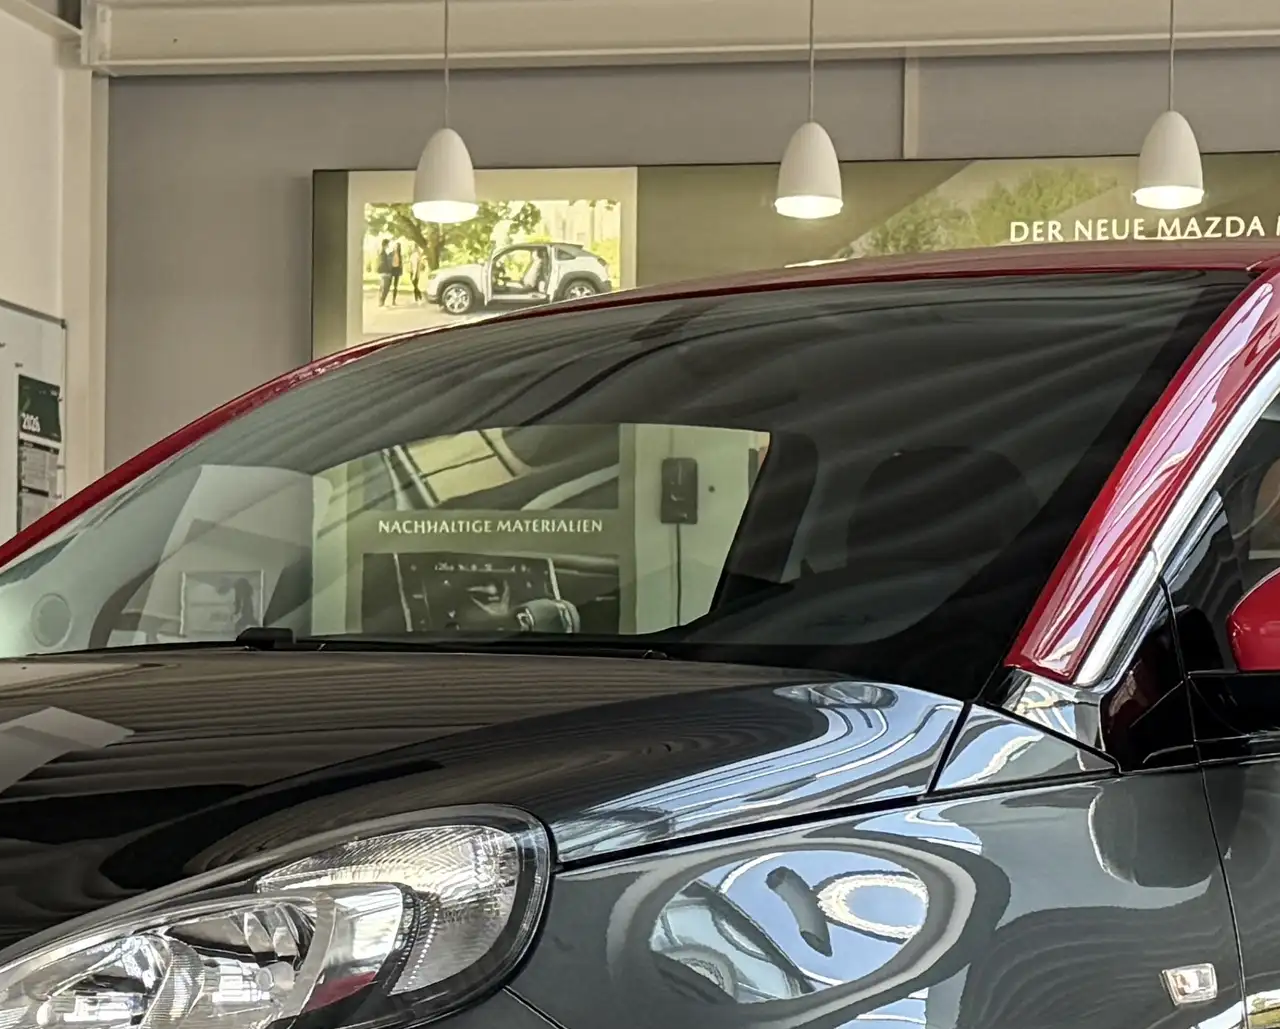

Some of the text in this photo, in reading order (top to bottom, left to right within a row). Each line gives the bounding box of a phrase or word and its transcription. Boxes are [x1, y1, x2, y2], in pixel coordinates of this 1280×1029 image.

[1010, 220, 1064, 242] DER
[1074, 218, 1146, 241] NEUE
[1157, 215, 1266, 240] MAZDA
[378, 518, 603, 534] NACHHALTIGE MATERIALIEN
